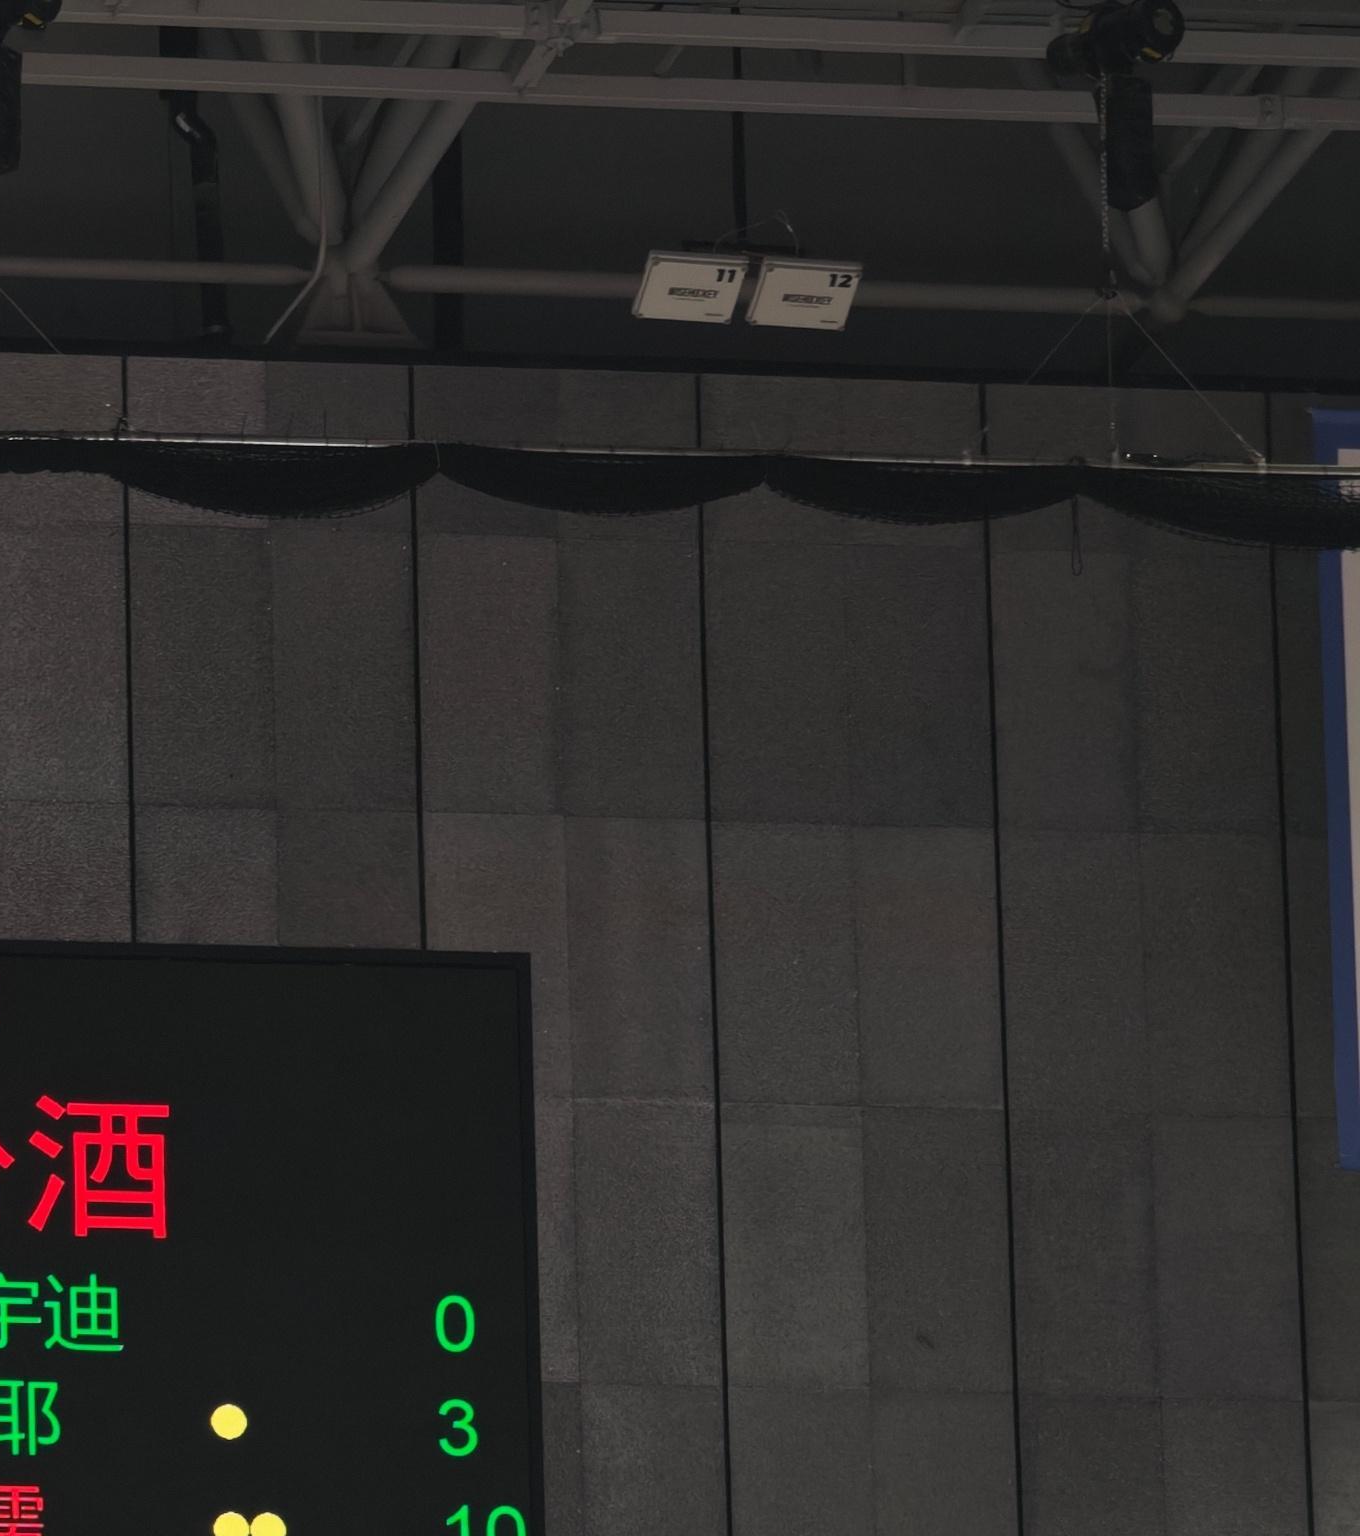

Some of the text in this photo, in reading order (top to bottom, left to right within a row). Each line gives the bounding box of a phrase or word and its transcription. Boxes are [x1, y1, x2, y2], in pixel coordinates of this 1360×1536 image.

[716, 267, 738, 283] 11
[827, 273, 853, 289] 12
[434, 1293, 476, 1354] 0
[437, 1397, 479, 1458] 3
